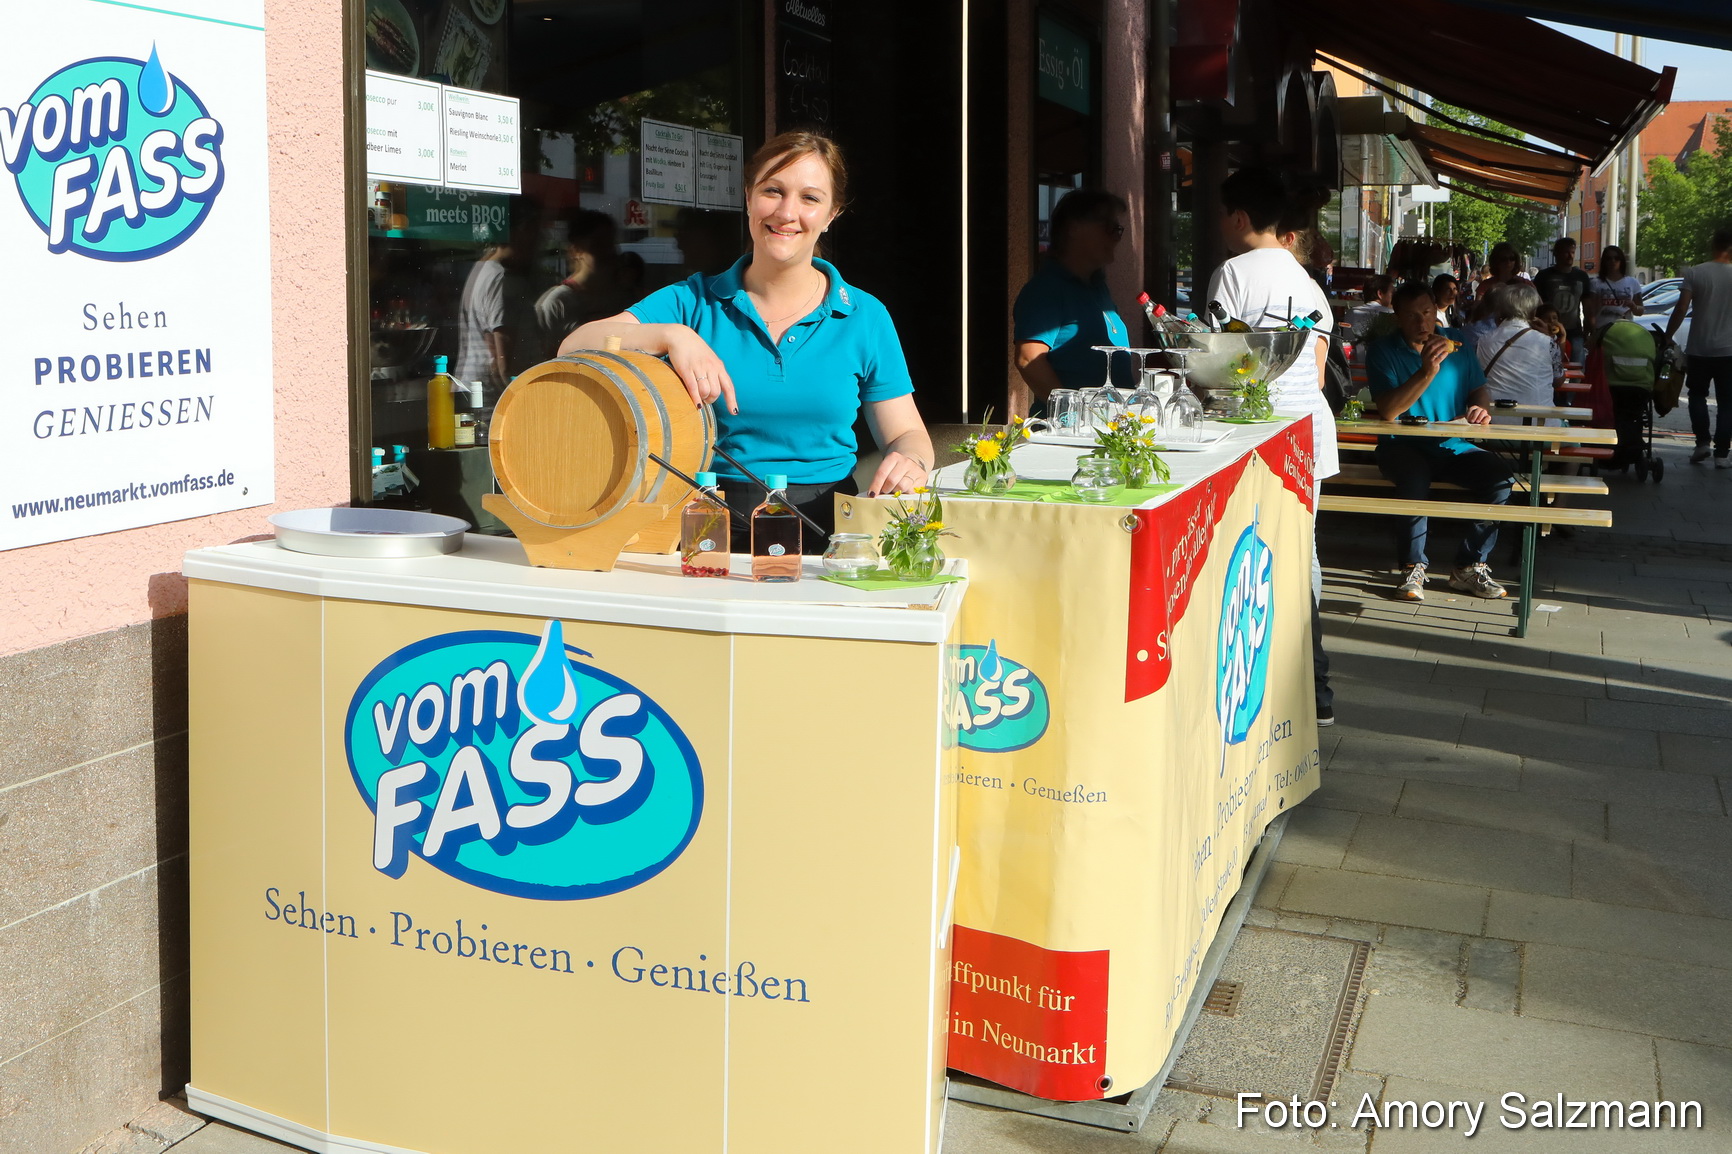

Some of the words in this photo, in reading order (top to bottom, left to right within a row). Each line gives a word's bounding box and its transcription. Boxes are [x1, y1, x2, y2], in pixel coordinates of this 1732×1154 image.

[785, 0, 826, 26] Aktuelles
[1038, 38, 1064, 90] Essig
[1072, 49, 1083, 90] Öl
[387, 98, 397, 106] pur
[418, 101, 434, 112] 3,00€
[449, 107, 475, 119] Sauvignon
[475, 111, 489, 122] Blanc
[0, 77, 127, 172] vom
[387, 128, 398, 138] mit
[450, 127, 469, 139] Riesling
[469, 130, 499, 142] Weinschorle
[384, 144, 402, 155] Limes
[418, 148, 434, 158] 3,00€
[450, 162, 467, 172] Merlot
[675, 147, 689, 156] Cocktail
[48, 117, 222, 252] FASS
[426, 204, 468, 224] meets
[472, 204, 506, 231] BBQ!
[82, 301, 168, 331] Sehen
[34, 348, 212, 385] PROBIEREN
[33, 395, 214, 439] GENIESSEN
[11, 469, 235, 519] www.neumarkt.vomfass.de
[372, 658, 514, 760] vom
[373, 692, 650, 874] FASS
[1023, 777, 1107, 804] Genießen
[265, 887, 359, 938] Sehen
[390, 911, 574, 973] Probieren
[611, 946, 810, 1002] Genießen
[953, 961, 1032, 1004] ffpunkt
[1038, 985, 1075, 1012] für
[954, 1011, 974, 1038] in
[981, 1018, 1097, 1065] Neumarkt
